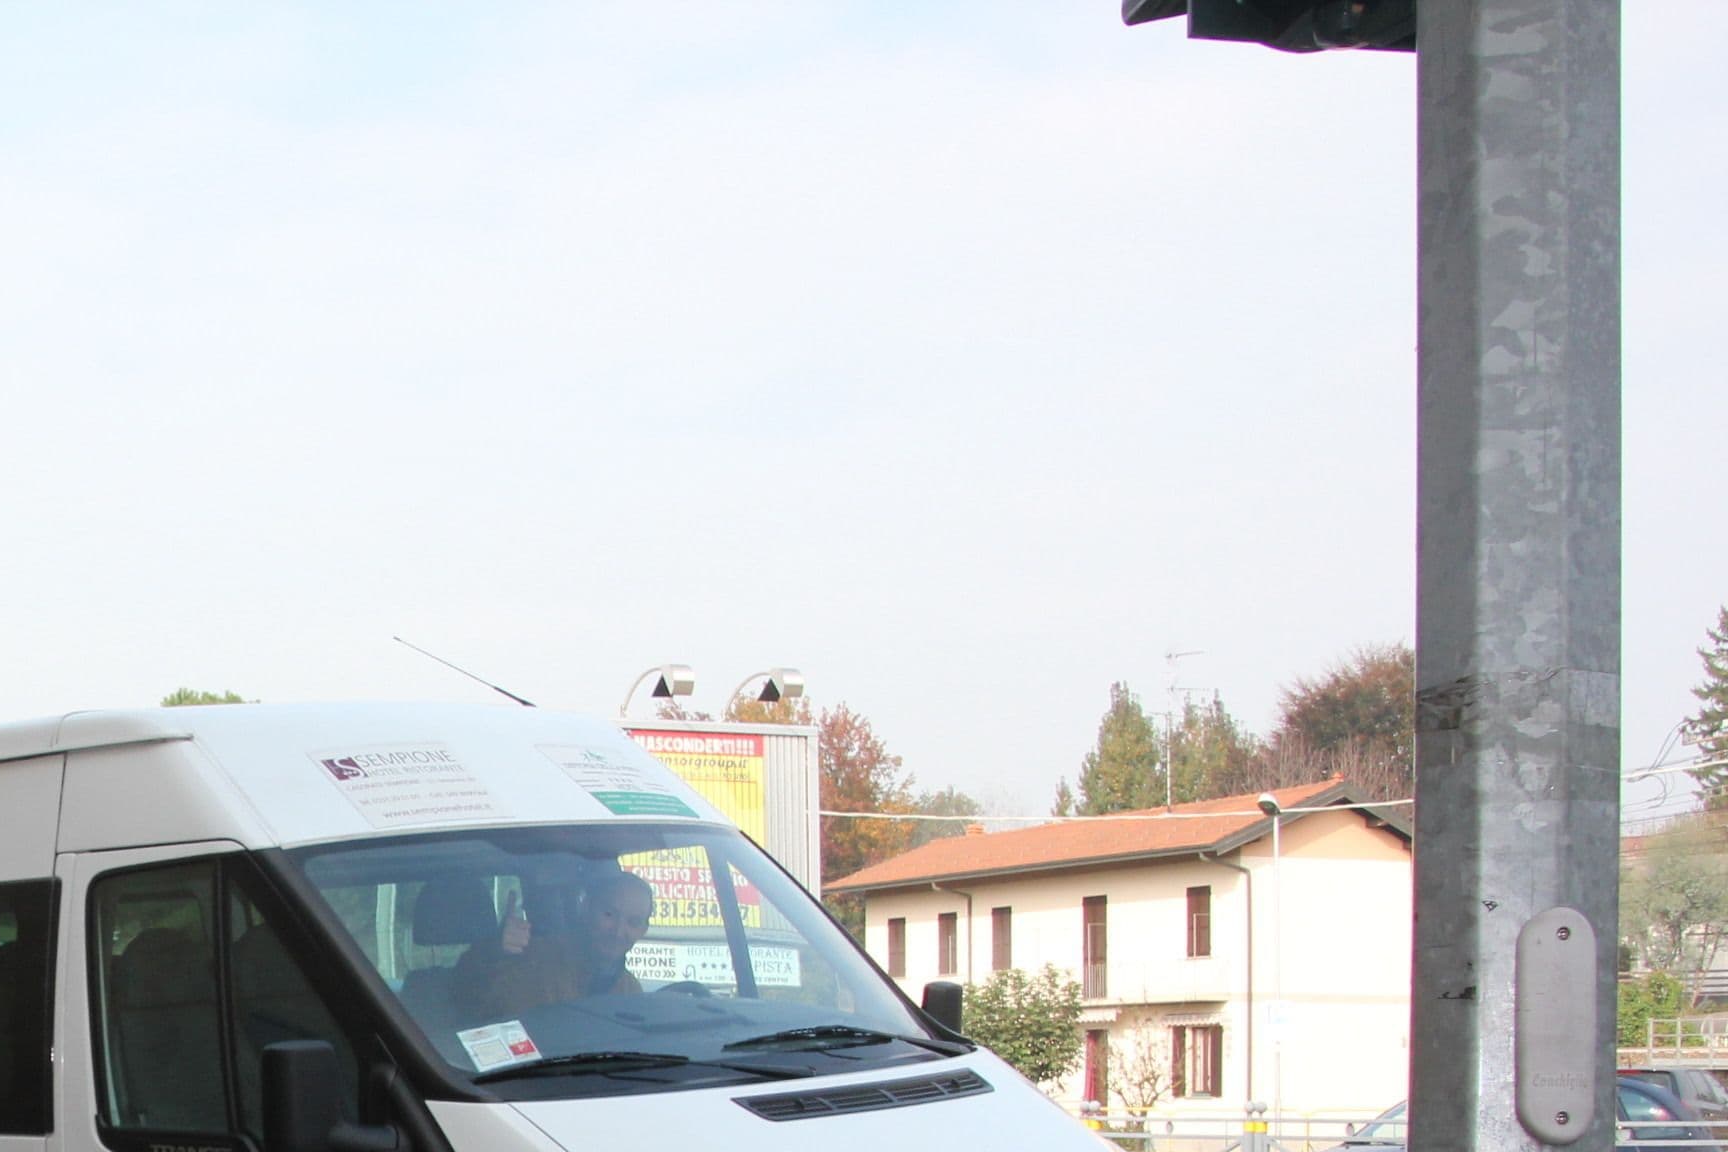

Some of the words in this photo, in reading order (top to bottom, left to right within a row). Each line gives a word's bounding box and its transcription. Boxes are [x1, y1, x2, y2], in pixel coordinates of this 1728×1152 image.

[355, 750, 456, 768] SEMPIONE
[632, 866, 690, 882] QUESTO
[626, 957, 677, 968] MPIONE
[754, 960, 793, 975] PISTA
